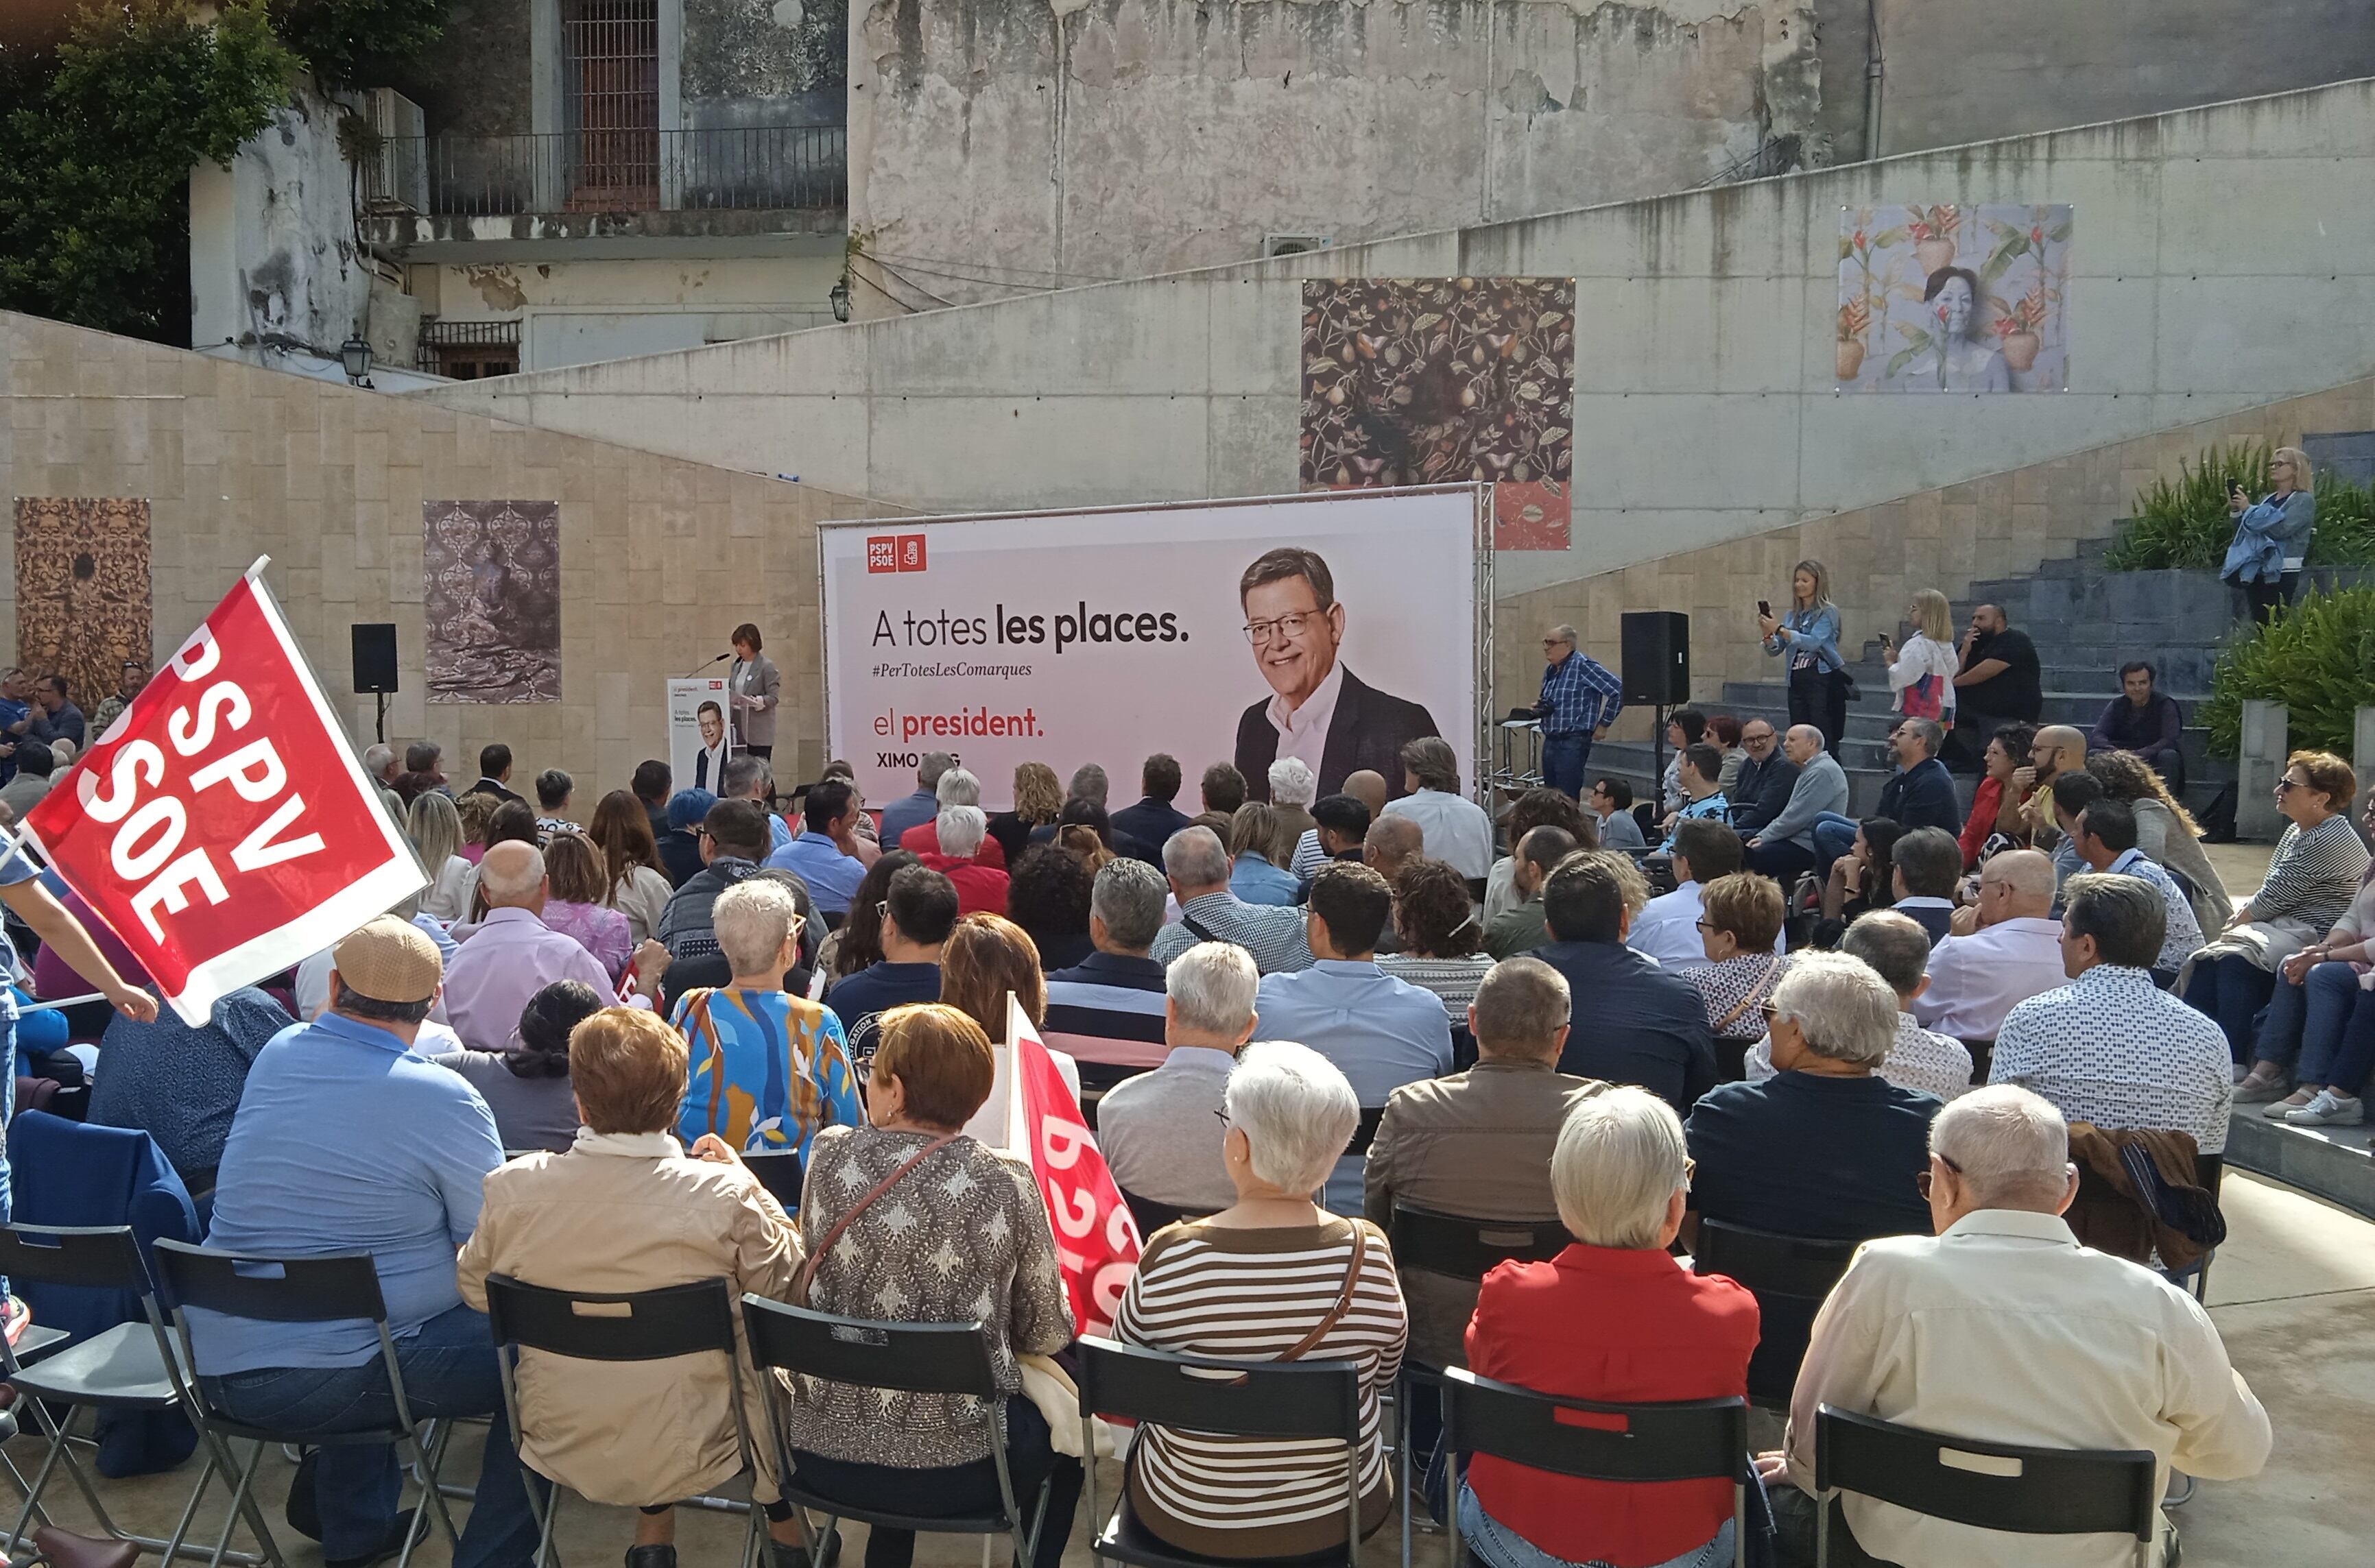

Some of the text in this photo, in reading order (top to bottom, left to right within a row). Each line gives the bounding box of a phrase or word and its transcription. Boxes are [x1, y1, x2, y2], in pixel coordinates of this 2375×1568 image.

[869, 542, 894, 555] PSPV
[870, 554, 895, 568] PSOE
[872, 601, 1190, 655] A totes les places.
[872, 661, 1032, 680] #PerTotesLesComarques
[874, 706, 1045, 743] el president.
[167, 623, 326, 873] PSPV
[876, 752, 919, 768] XIMO
